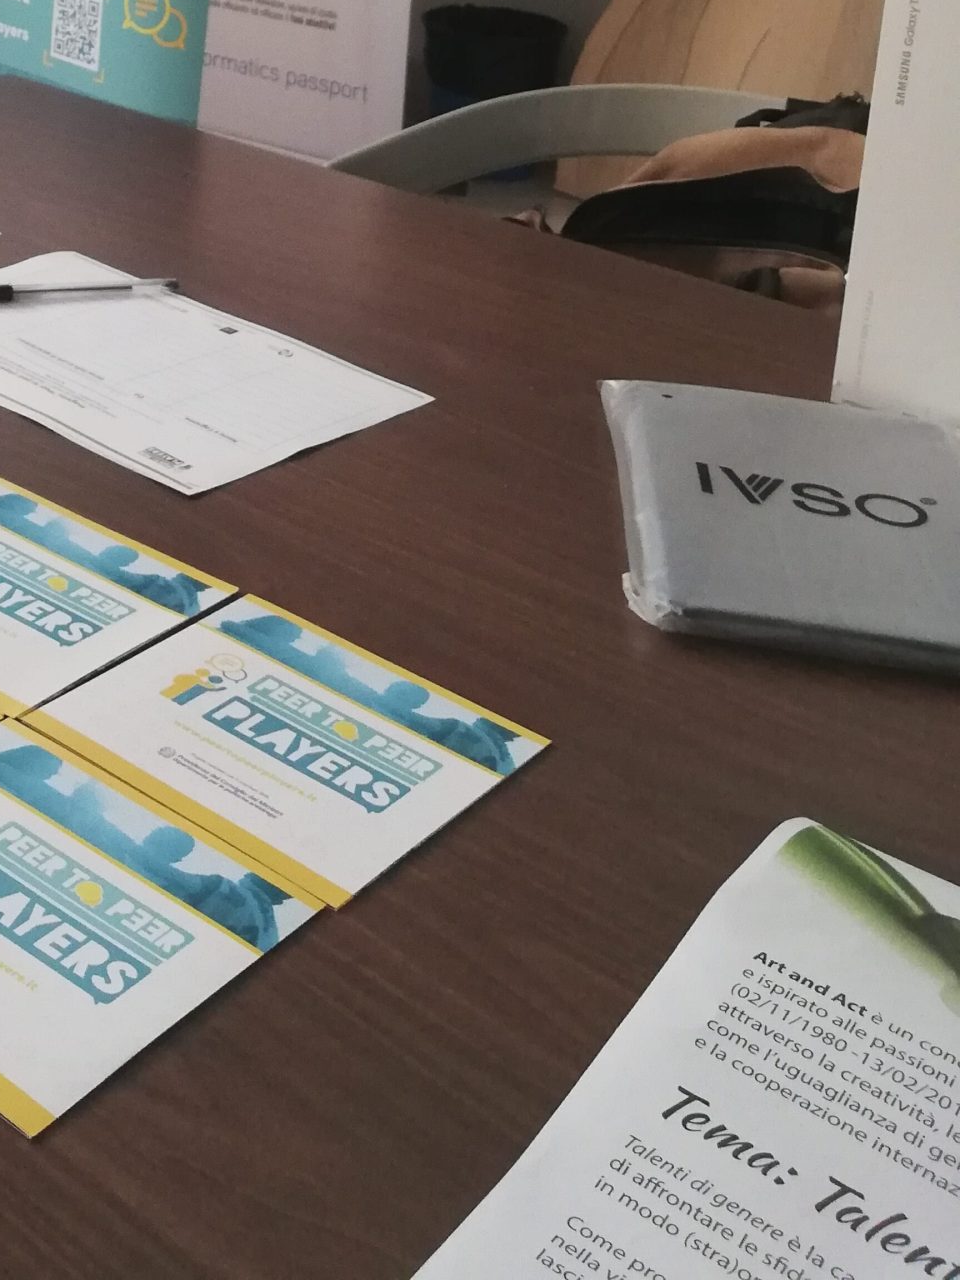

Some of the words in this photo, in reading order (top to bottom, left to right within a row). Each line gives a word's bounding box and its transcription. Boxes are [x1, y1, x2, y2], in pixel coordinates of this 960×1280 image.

[285, 68, 369, 105] passport
[895, 51, 911, 106] SAMSUNG
[904, 7, 921, 47] Galaxy
[253, 677, 324, 725] PEER
[212, 700, 400, 808] PLAYERS
[730, 983, 849, 1053] (02/11/1980
[742, 967, 755, 979] e
[757, 973, 829, 1018] ispirato
[832, 1016, 867, 1040] alle
[869, 1036, 957, 1089] passioni
[753, 951, 786, 974] Art
[788, 971, 831, 996] and
[831, 993, 868, 1017] Act
[871, 1012, 883, 1025] è
[888, 1022, 914, 1042] un
[694, 1036, 707, 1050] e
[709, 1043, 728, 1062] la
[731, 1058, 869, 1143] cooperazione
[706, 1019, 760, 1056] come
[763, 1047, 899, 1134] l'uguaglianza
[903, 1128, 926, 1149] di
[717, 1001, 815, 1061] attraverso
[818, 1053, 837, 1073] la
[841, 1070, 940, 1133] creatività,
[661, 1084, 799, 1186] Tema:
[567, 1216, 626, 1260] Come
[595, 1175, 615, 1196] in
[618, 1192, 679, 1236] modo
[684, 1231, 763, 1280] (stra)o
[609, 1158, 632, 1176] di
[632, 1171, 734, 1242] affrontare
[738, 1233, 759, 1257] le
[624, 1134, 692, 1183] Talenti
[690, 1179, 715, 1195] di
[709, 1193, 784, 1242] genere
[787, 1235, 801, 1253] è
[805, 1245, 825, 1269] la
[551, 1234, 601, 1272] nella
